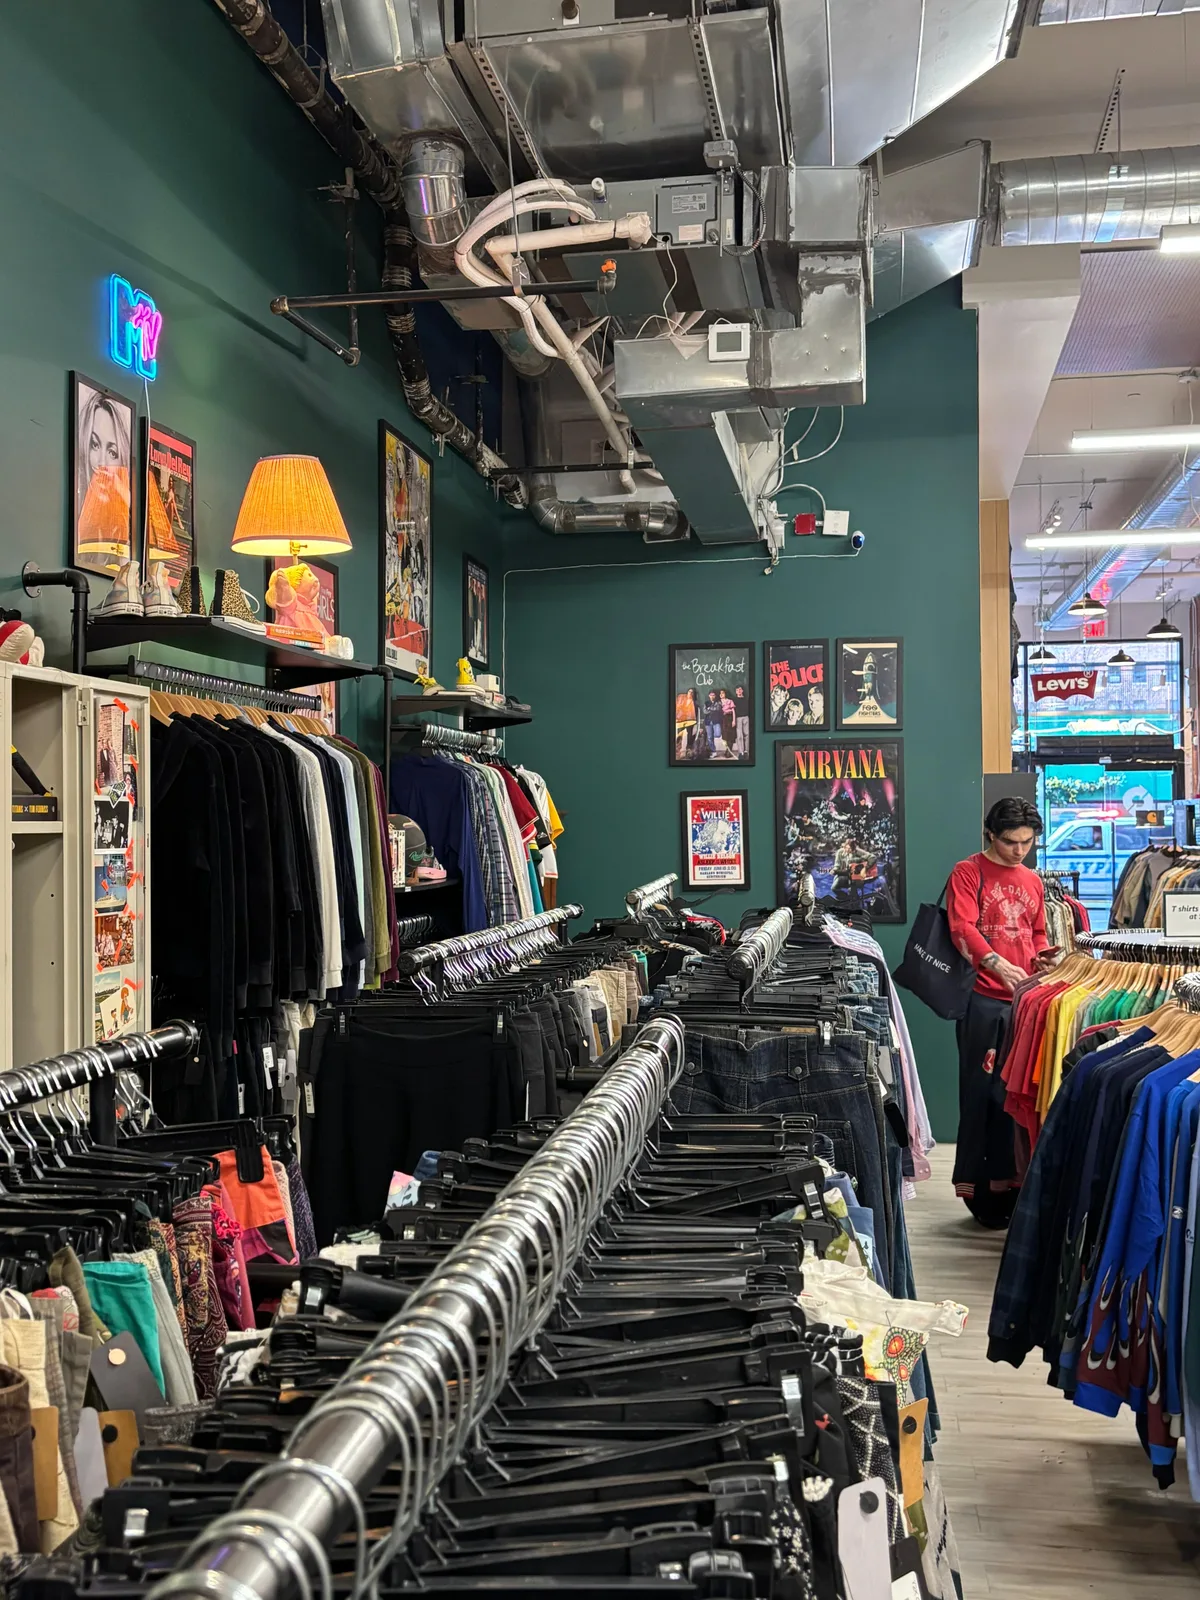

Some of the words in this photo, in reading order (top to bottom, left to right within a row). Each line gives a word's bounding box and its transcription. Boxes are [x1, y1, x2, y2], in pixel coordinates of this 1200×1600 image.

[691, 656, 746, 674] Breakfast
[770, 660, 790, 673] THE
[695, 672, 714, 686] Club
[862, 704, 878, 712] FOO
[793, 749, 887, 780] NIRVANA
[701, 810, 731, 820] WILLIE
[925, 954, 934, 963] IT
[932, 958, 952, 974] NICE
